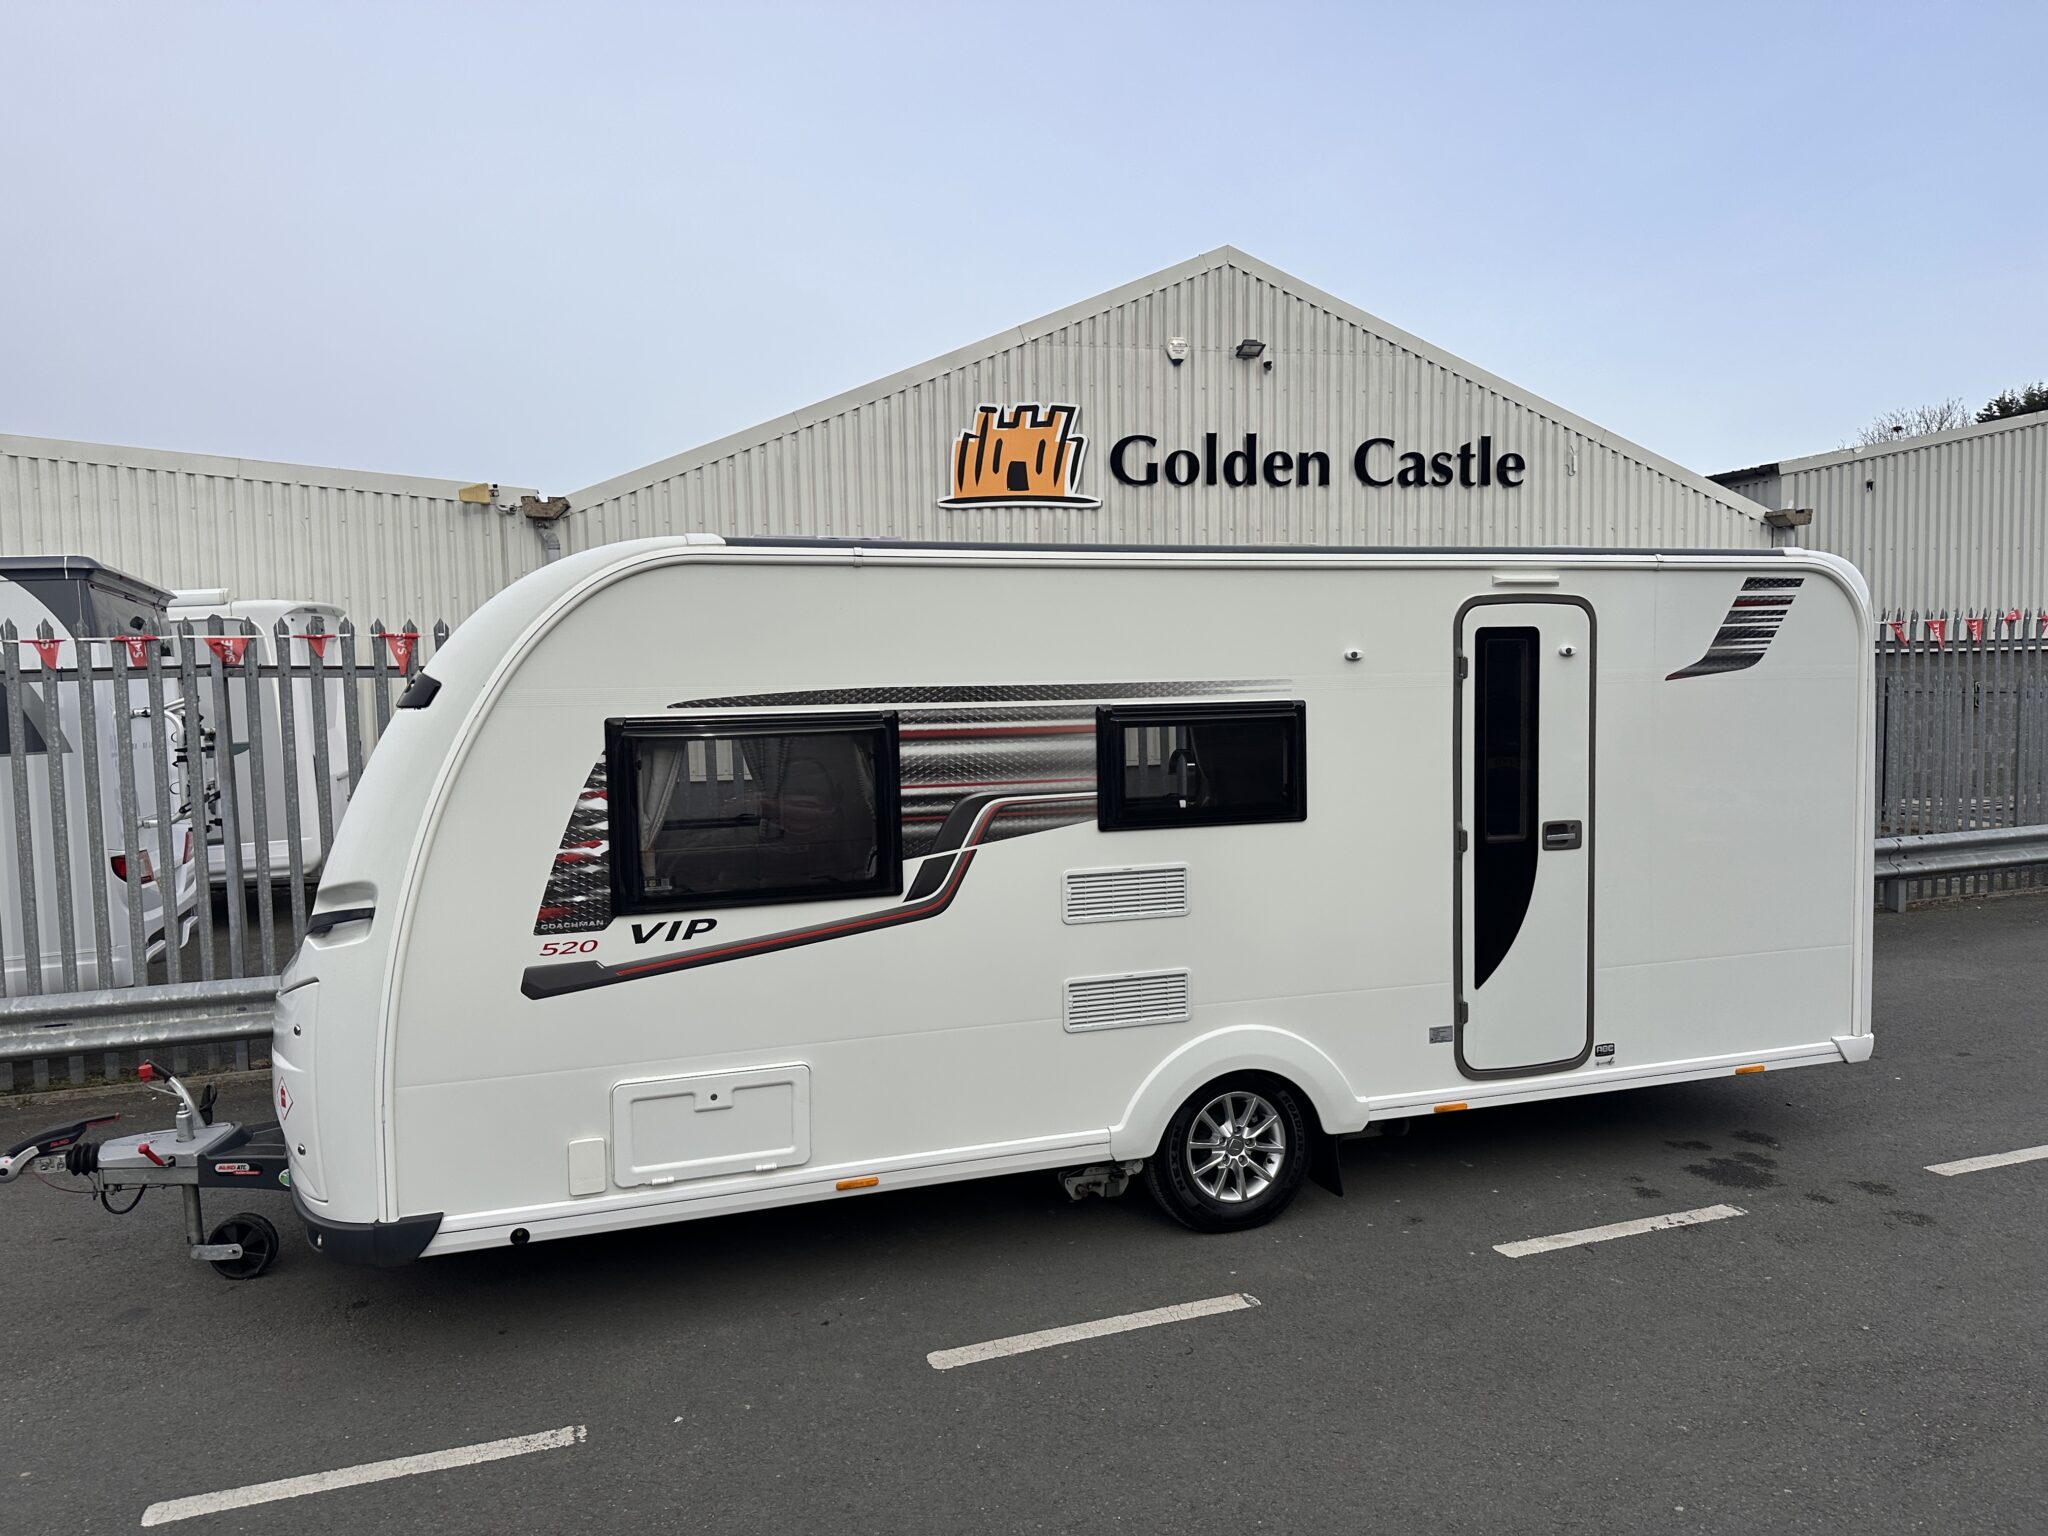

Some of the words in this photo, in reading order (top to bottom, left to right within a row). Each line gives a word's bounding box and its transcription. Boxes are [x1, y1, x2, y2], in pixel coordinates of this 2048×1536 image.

[1109, 432, 1331, 488] Golden
[1353, 435, 1527, 488] Castle
[540, 920, 605, 931] COACHMAN
[631, 918, 718, 945] VIP
[539, 939, 599, 957] 520
[1169, 1126, 1186, 1192] NEXEN
